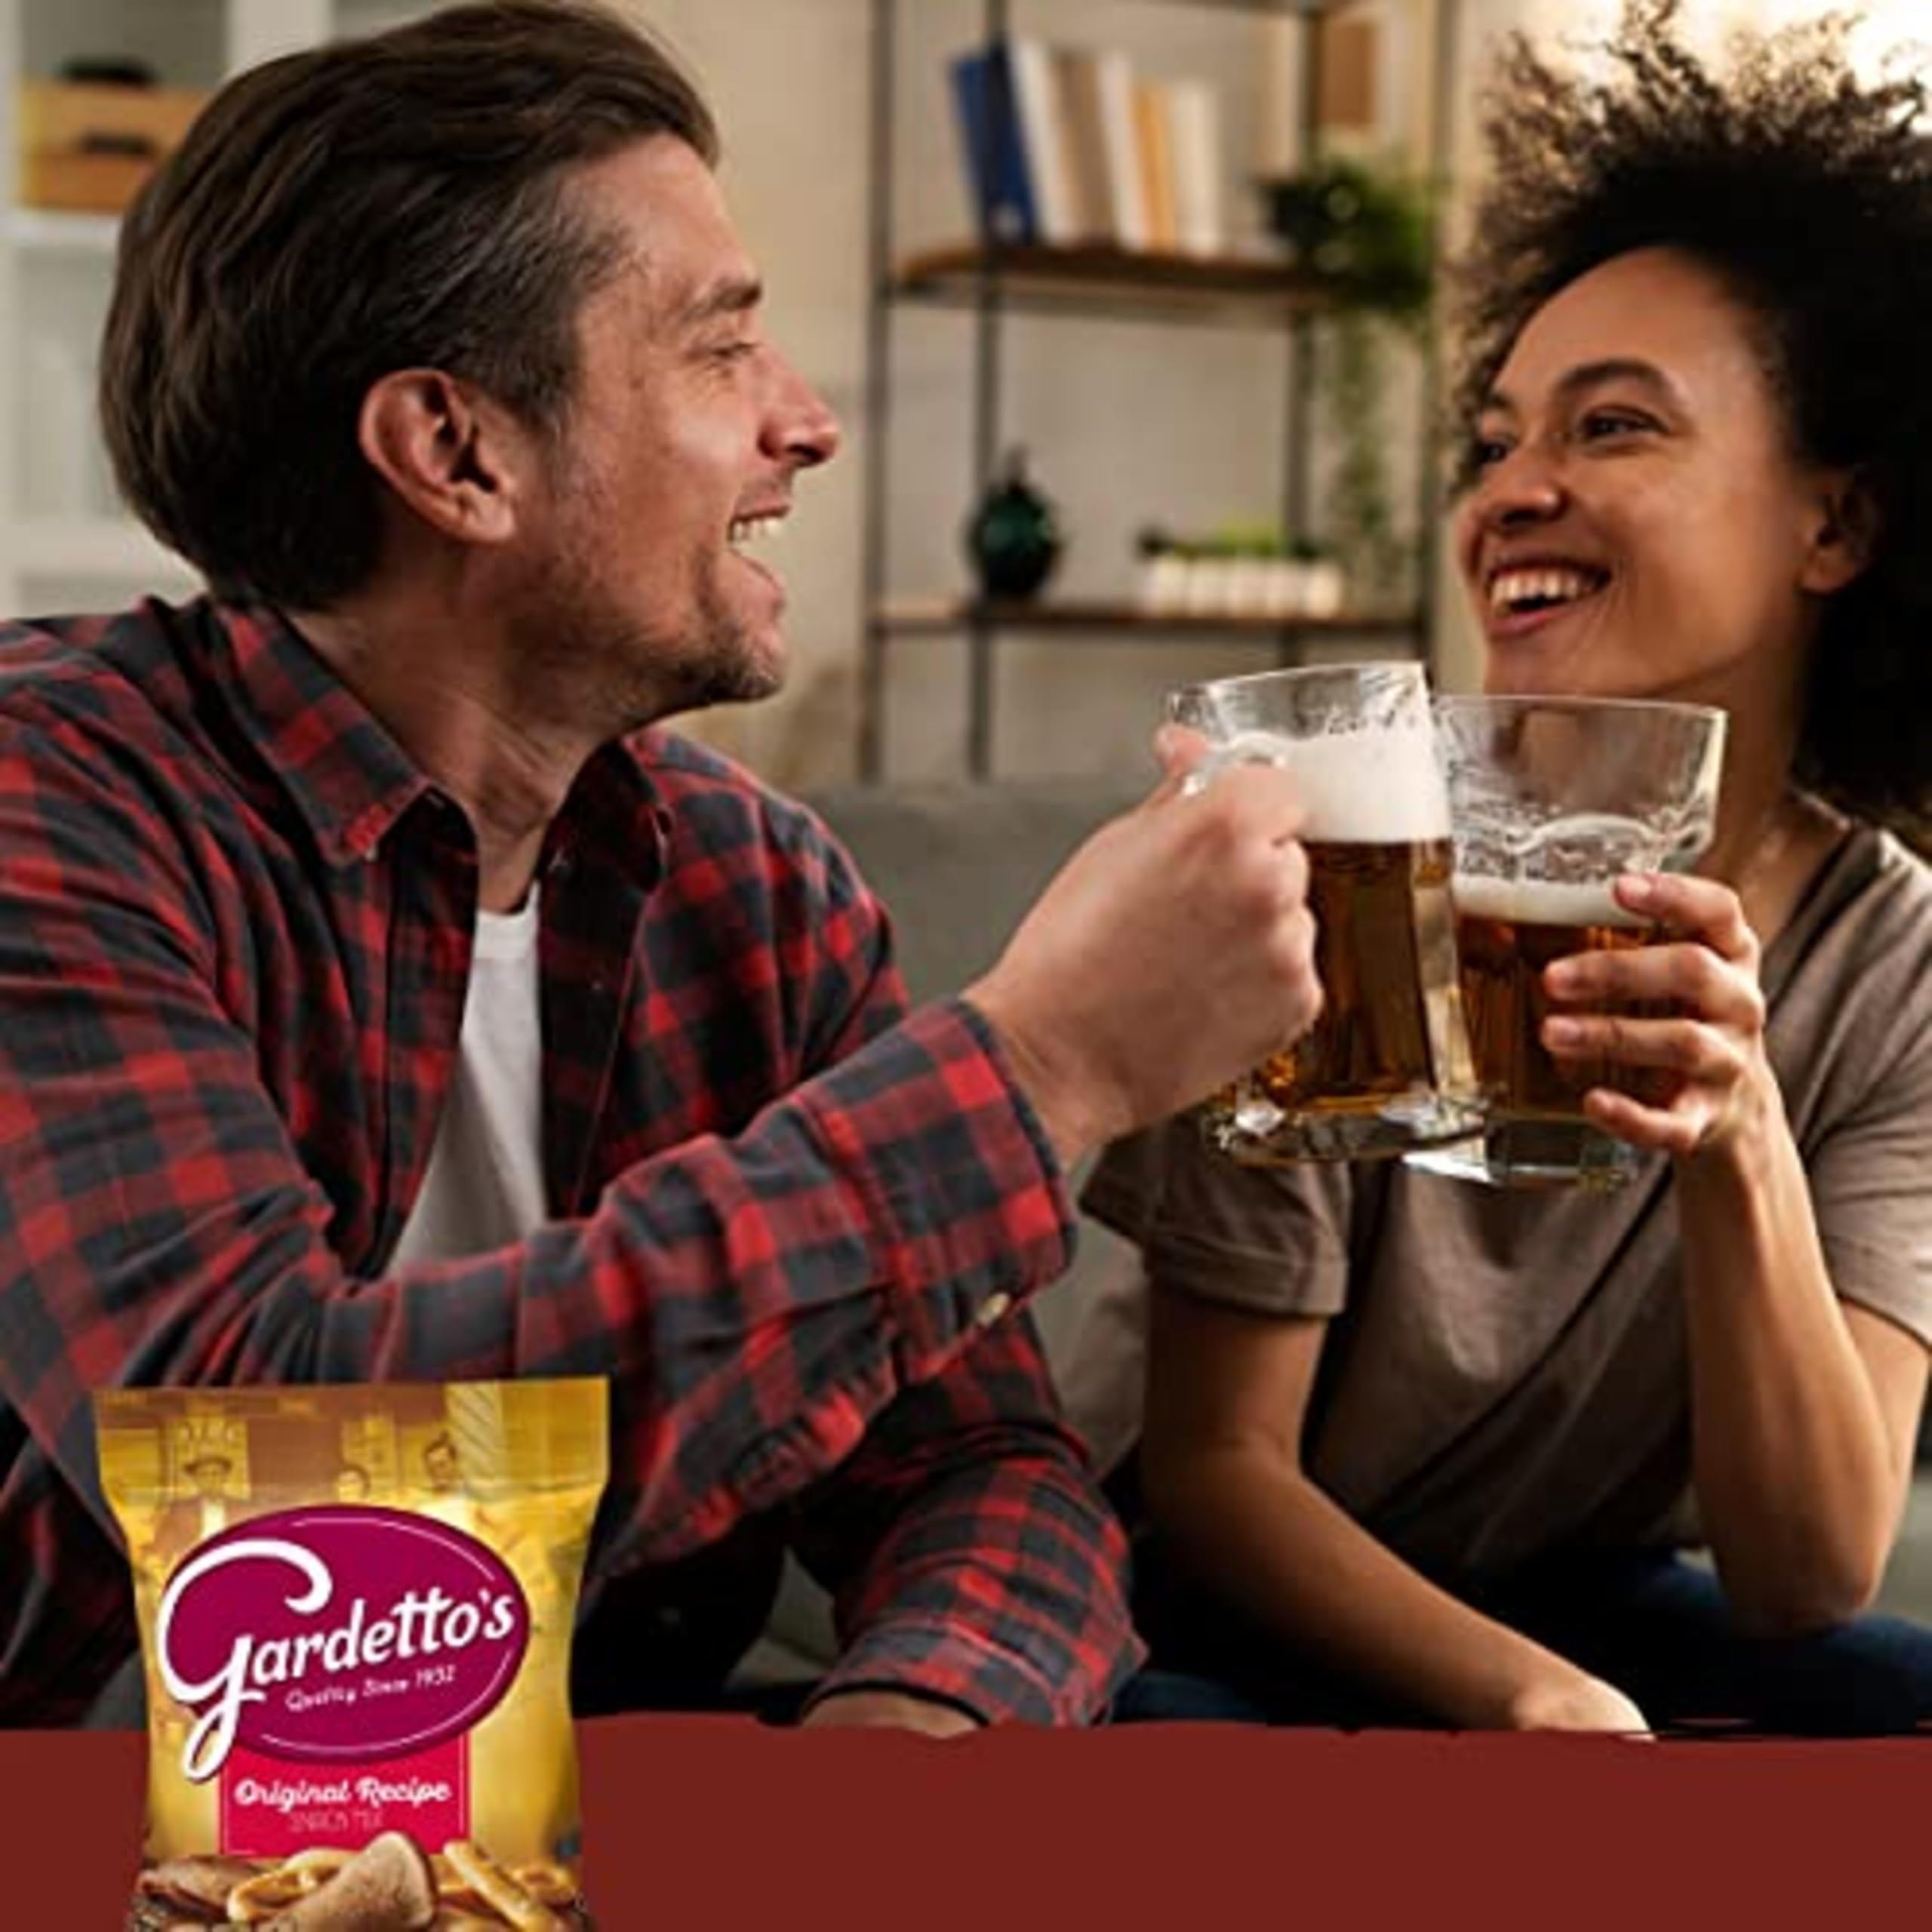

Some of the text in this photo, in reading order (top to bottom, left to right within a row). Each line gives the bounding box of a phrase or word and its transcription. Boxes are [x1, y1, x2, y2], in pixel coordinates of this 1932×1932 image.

[156, 1538, 515, 1780] Gardetto's
[234, 1776, 451, 1813] Original Recipe
